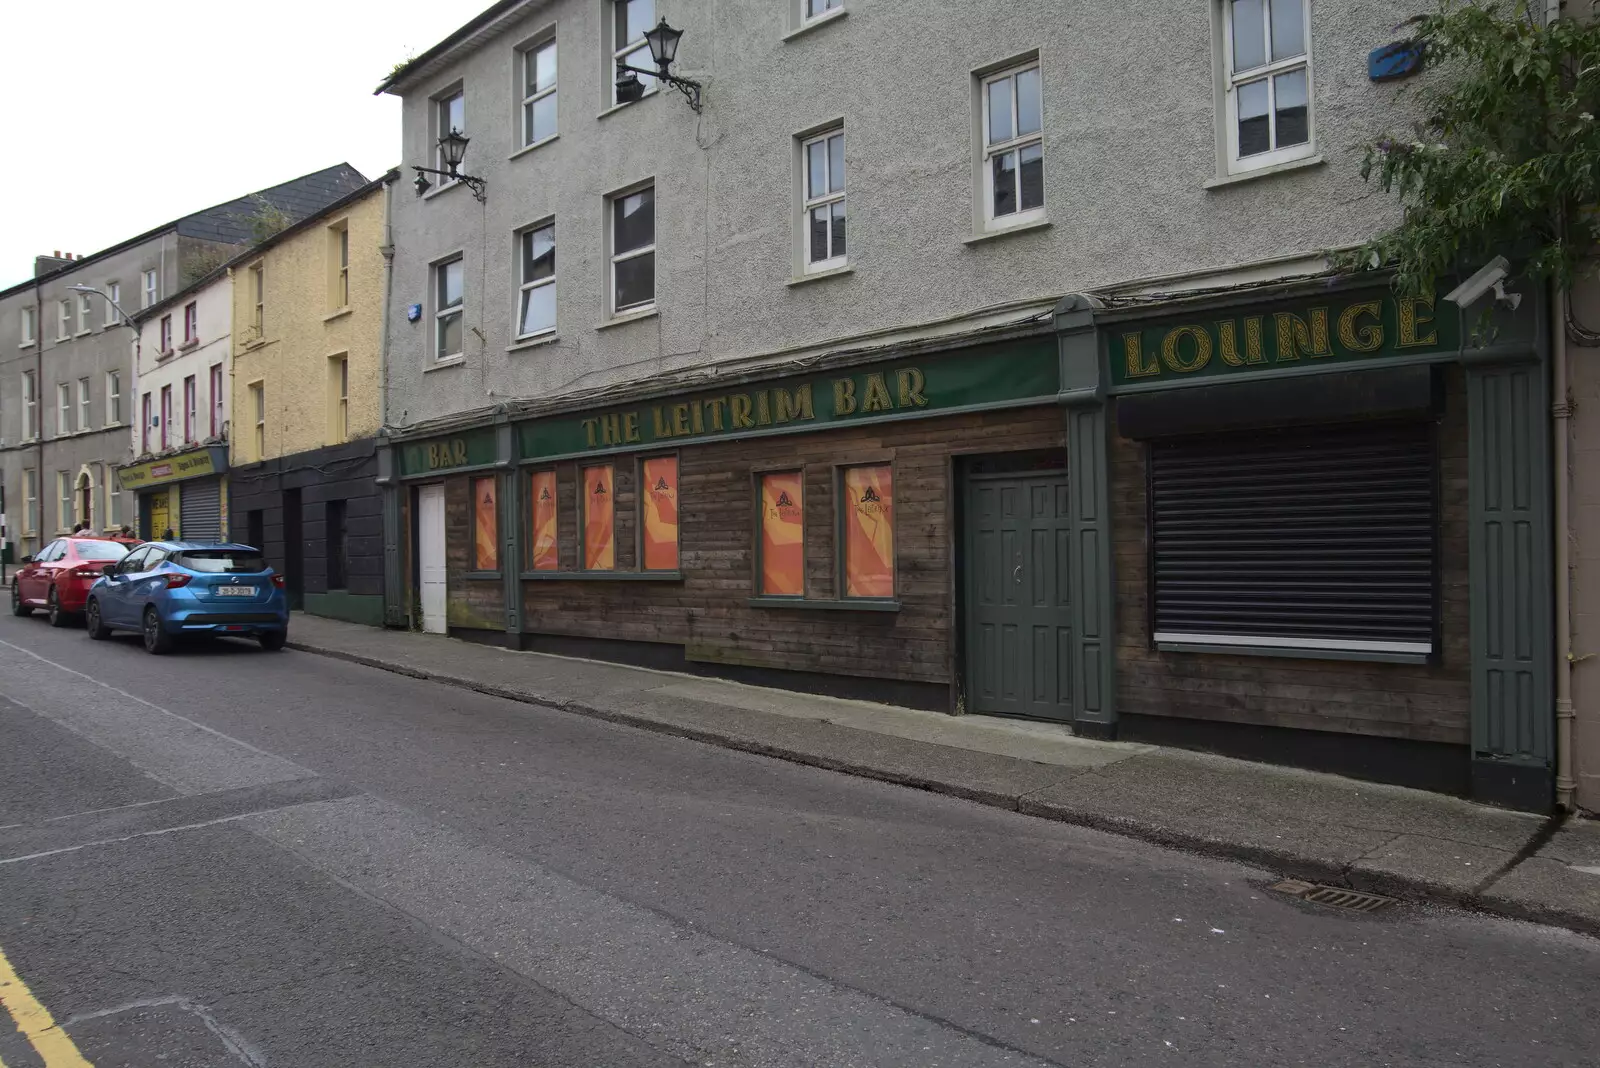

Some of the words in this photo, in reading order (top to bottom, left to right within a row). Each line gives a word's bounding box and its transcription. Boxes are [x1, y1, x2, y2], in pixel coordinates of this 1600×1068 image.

[1122, 296, 1438, 379] LOUNGE
[581, 411, 641, 447] THE
[653, 383, 816, 439] LEITRIM
[832, 367, 929, 416] BAR
[428, 439, 469, 469] BAR
